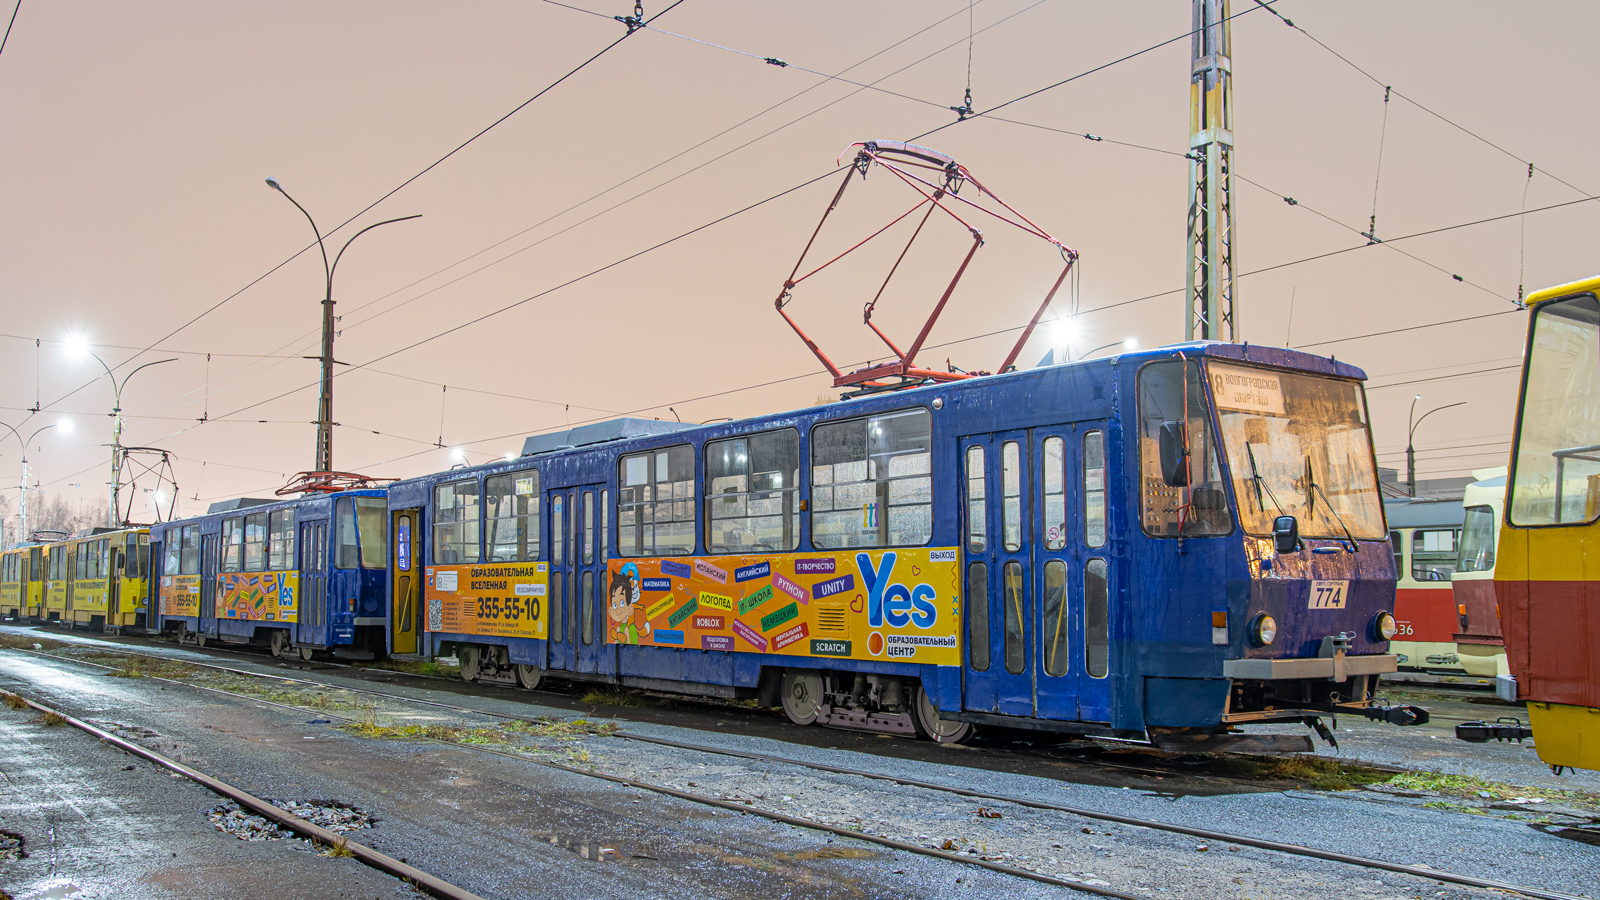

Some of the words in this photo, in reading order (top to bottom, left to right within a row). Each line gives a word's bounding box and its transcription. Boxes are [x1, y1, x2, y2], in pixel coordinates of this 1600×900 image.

[140, 536, 148, 544] 18
[471, 567, 534, 578] ОБРАЗОВАТЕЛЬНАЯ
[696, 563, 727, 581] ИСПАНСКИЙ
[736, 565, 770, 579] АНГЛИЙСКИЙ
[276, 572, 294, 607] Yes
[471, 581, 507, 590] ВСЕЛЕННАЯ
[777, 577, 804, 600] PYTHON
[821, 579, 845, 595] UNITY
[855, 551, 937, 628] Yes
[700, 594, 732, 609] ЛОГОПЕД
[1315, 587, 1341, 607] 774
[477, 597, 540, 621] 355-55-10
[670, 601, 697, 625] КИТАЙСКИЙ
[696, 618, 720, 627] ROBLOX
[762, 606, 796, 628] НЕМЕЦКИЙ
[655, 632, 684, 640] ФРАНЦУЗСКИЙ
[775, 625, 802, 642] МЕНТАЛЬНАЯ
[887, 635, 956, 646] ОБРАЗОВАТЕЛЬНЫЙ
[815, 643, 846, 652] SCRATCH
[887, 647, 915, 657] ЦЕНТР
